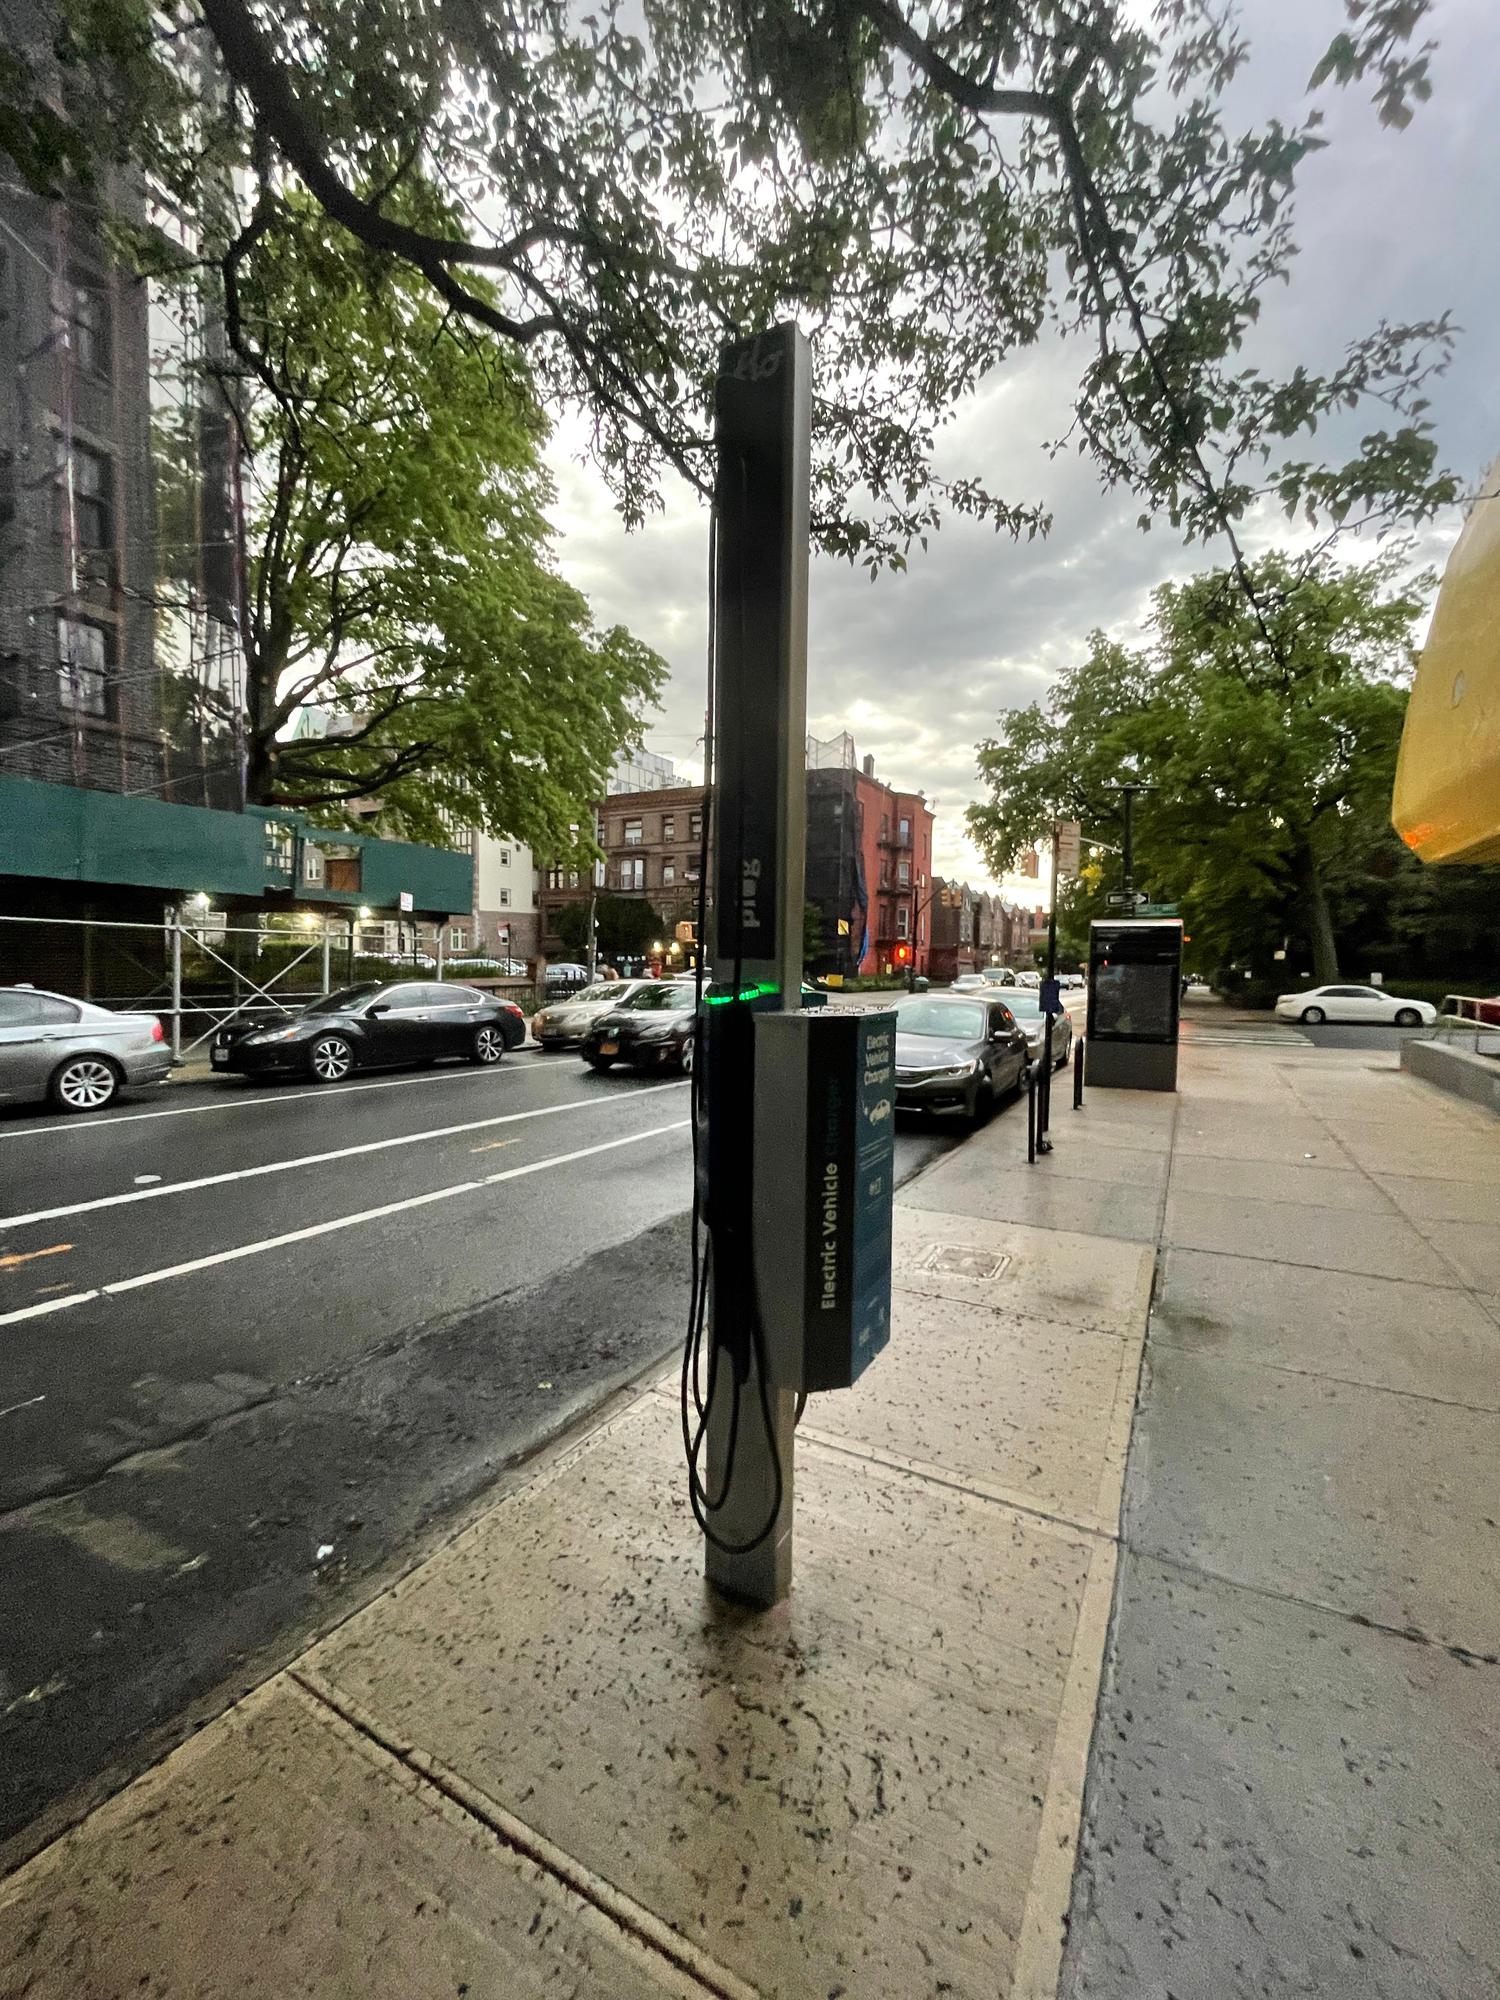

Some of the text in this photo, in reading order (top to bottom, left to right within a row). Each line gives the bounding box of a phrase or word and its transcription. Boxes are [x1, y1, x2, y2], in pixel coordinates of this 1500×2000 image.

[866, 1031, 890, 1050] Electric
[821, 1162, 840, 1236] Vehicle
[820, 1240, 837, 1310] Electric
